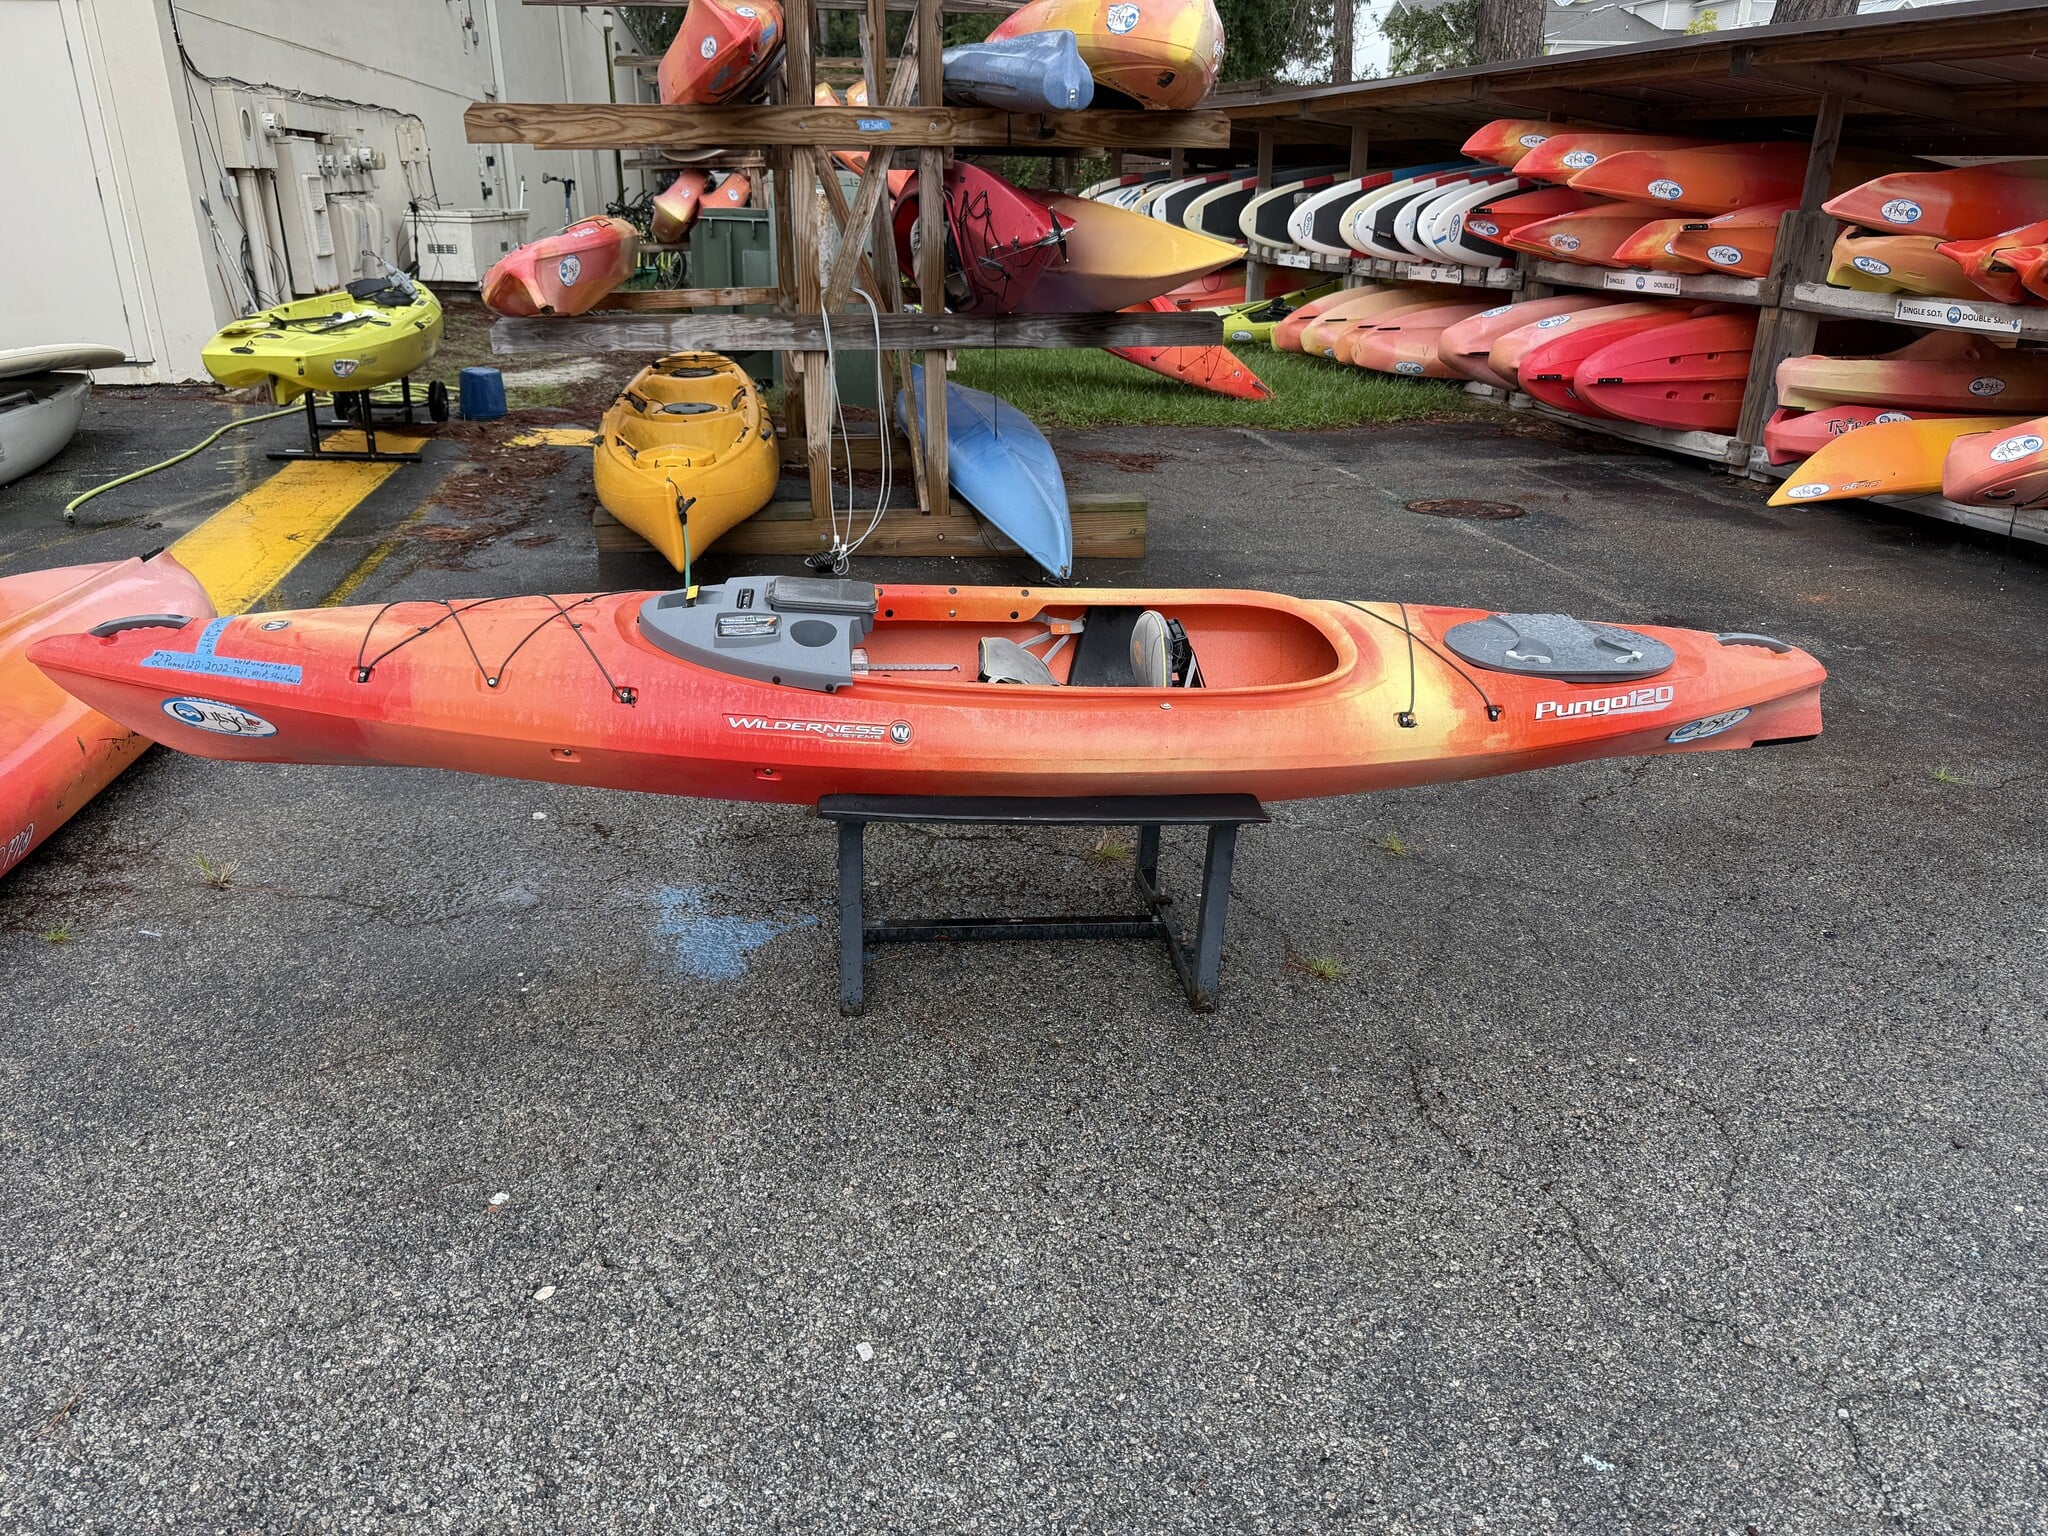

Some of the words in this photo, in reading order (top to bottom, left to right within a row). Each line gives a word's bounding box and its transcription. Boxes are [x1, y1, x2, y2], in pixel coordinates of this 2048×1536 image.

[1653, 281, 1676, 289] DOUBLES
[1902, 306, 1926, 316] SINGLE
[826, 732, 882, 740] SYSTEMS
